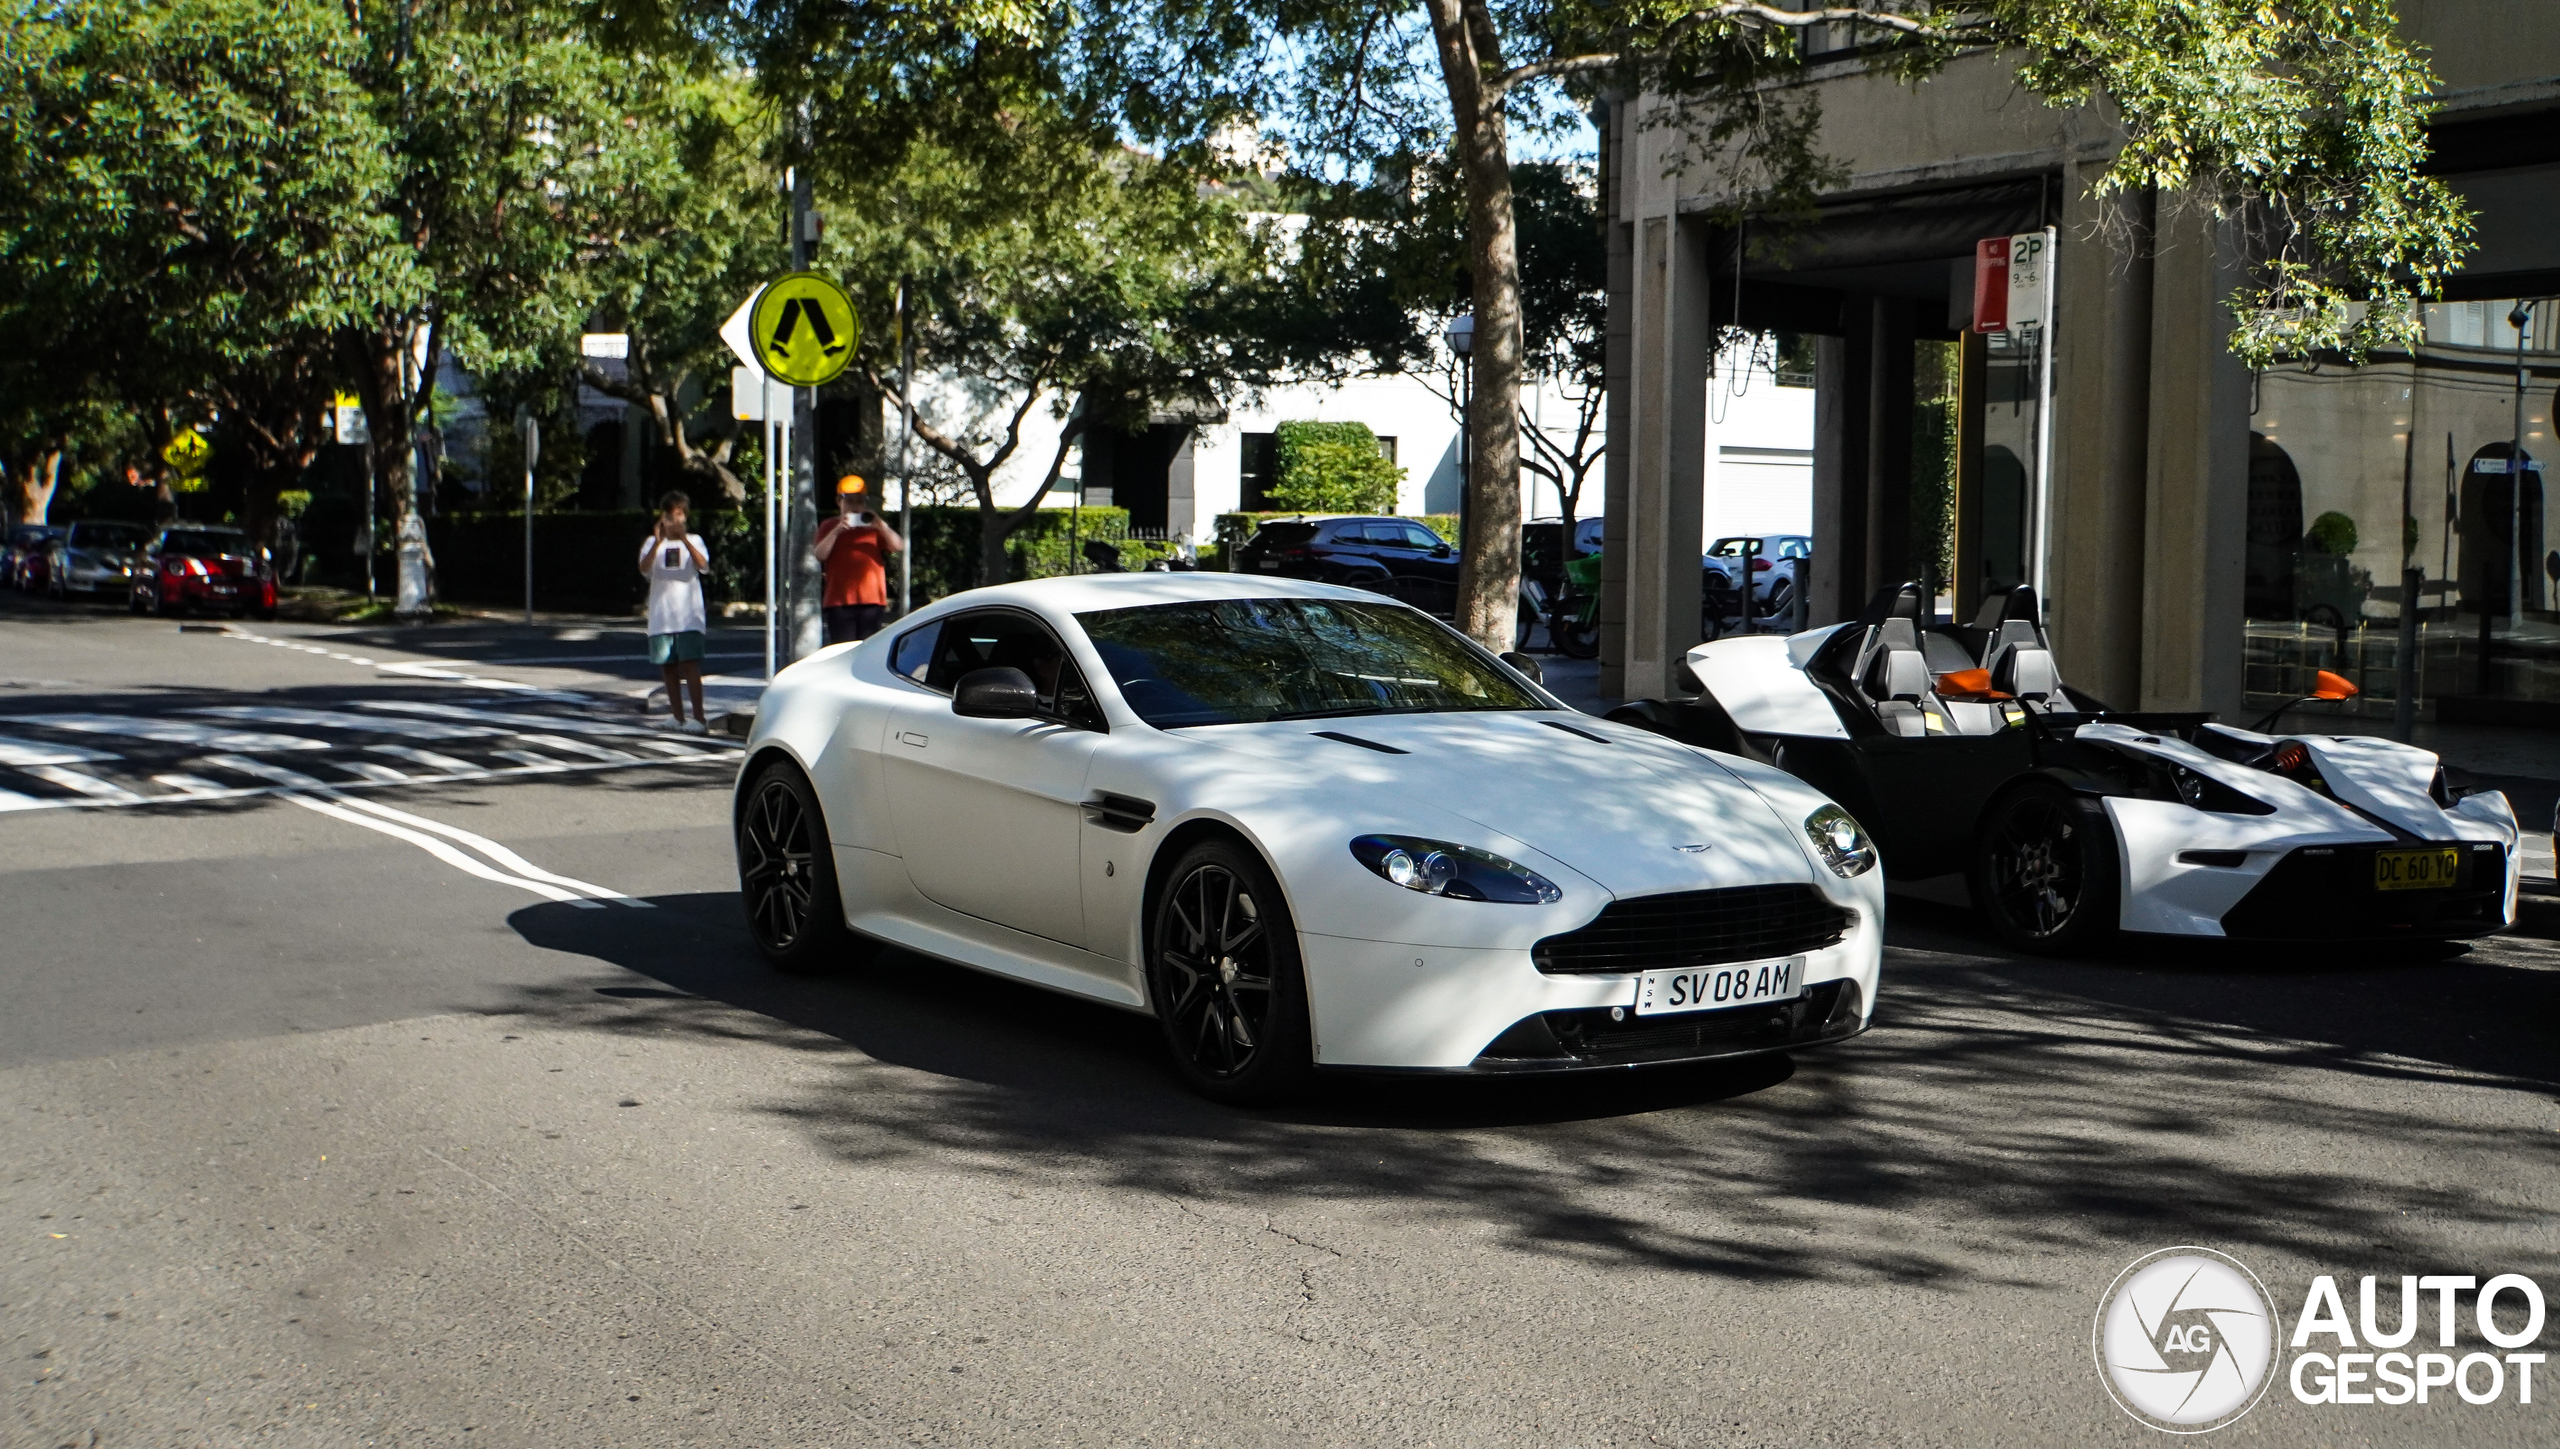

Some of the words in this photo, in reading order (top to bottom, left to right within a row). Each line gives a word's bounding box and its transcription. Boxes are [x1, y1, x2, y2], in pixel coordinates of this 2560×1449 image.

[2014, 240, 2042, 264] 2P
[2380, 856, 2402, 881] DC
[2408, 855, 2429, 880] 60
[1669, 972, 1710, 1006] SV
[1714, 969, 1750, 1002] 08
[1754, 963, 1791, 998] AM
